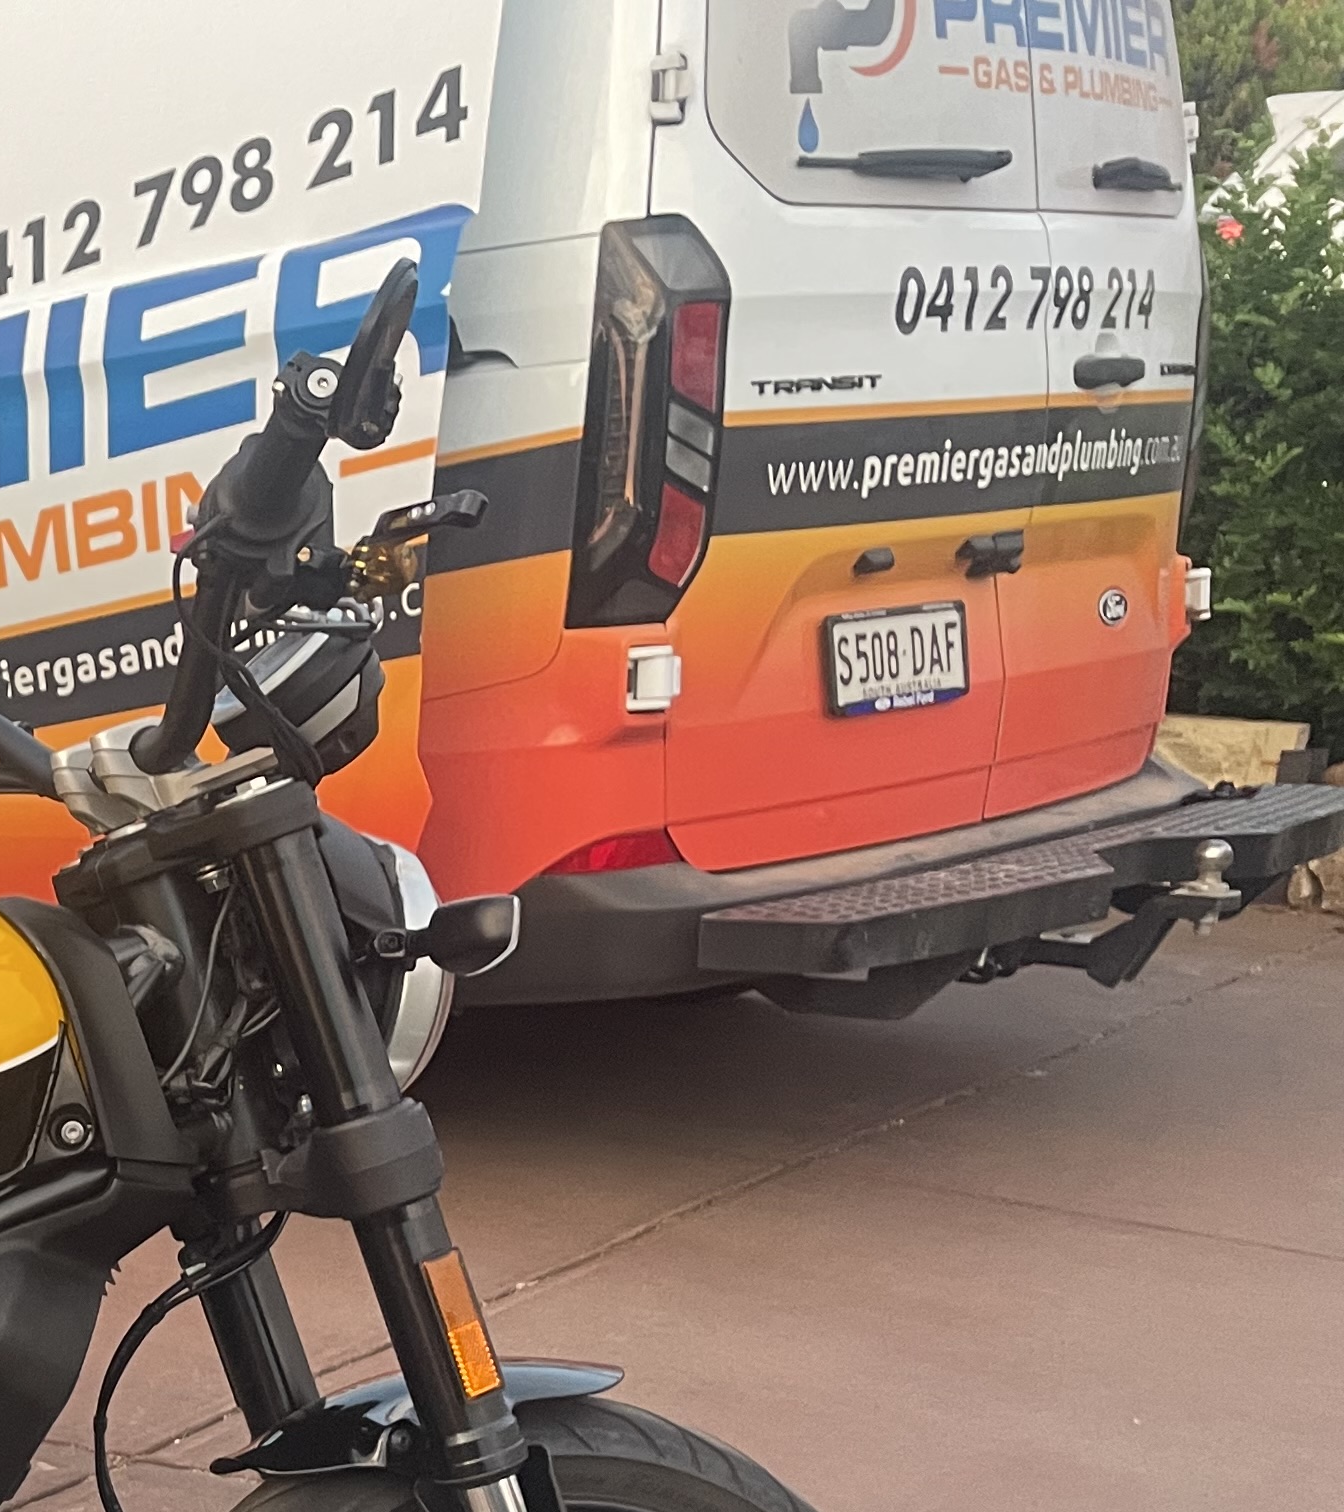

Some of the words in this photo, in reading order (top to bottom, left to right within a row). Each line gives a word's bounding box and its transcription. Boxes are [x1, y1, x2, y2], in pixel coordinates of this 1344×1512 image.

[973, 55, 1031, 93] GAS
[1039, 63, 1057, 95] &
[1063, 65, 1160, 112] PLUMBING
[132, 138, 275, 248] 798
[306, 66, 469, 190] 214
[895, 265, 1013, 335] 0412
[1026, 265, 1095, 331] 798
[1100, 266, 1155, 330] 214
[751, 374, 883, 396] TRANSIT
